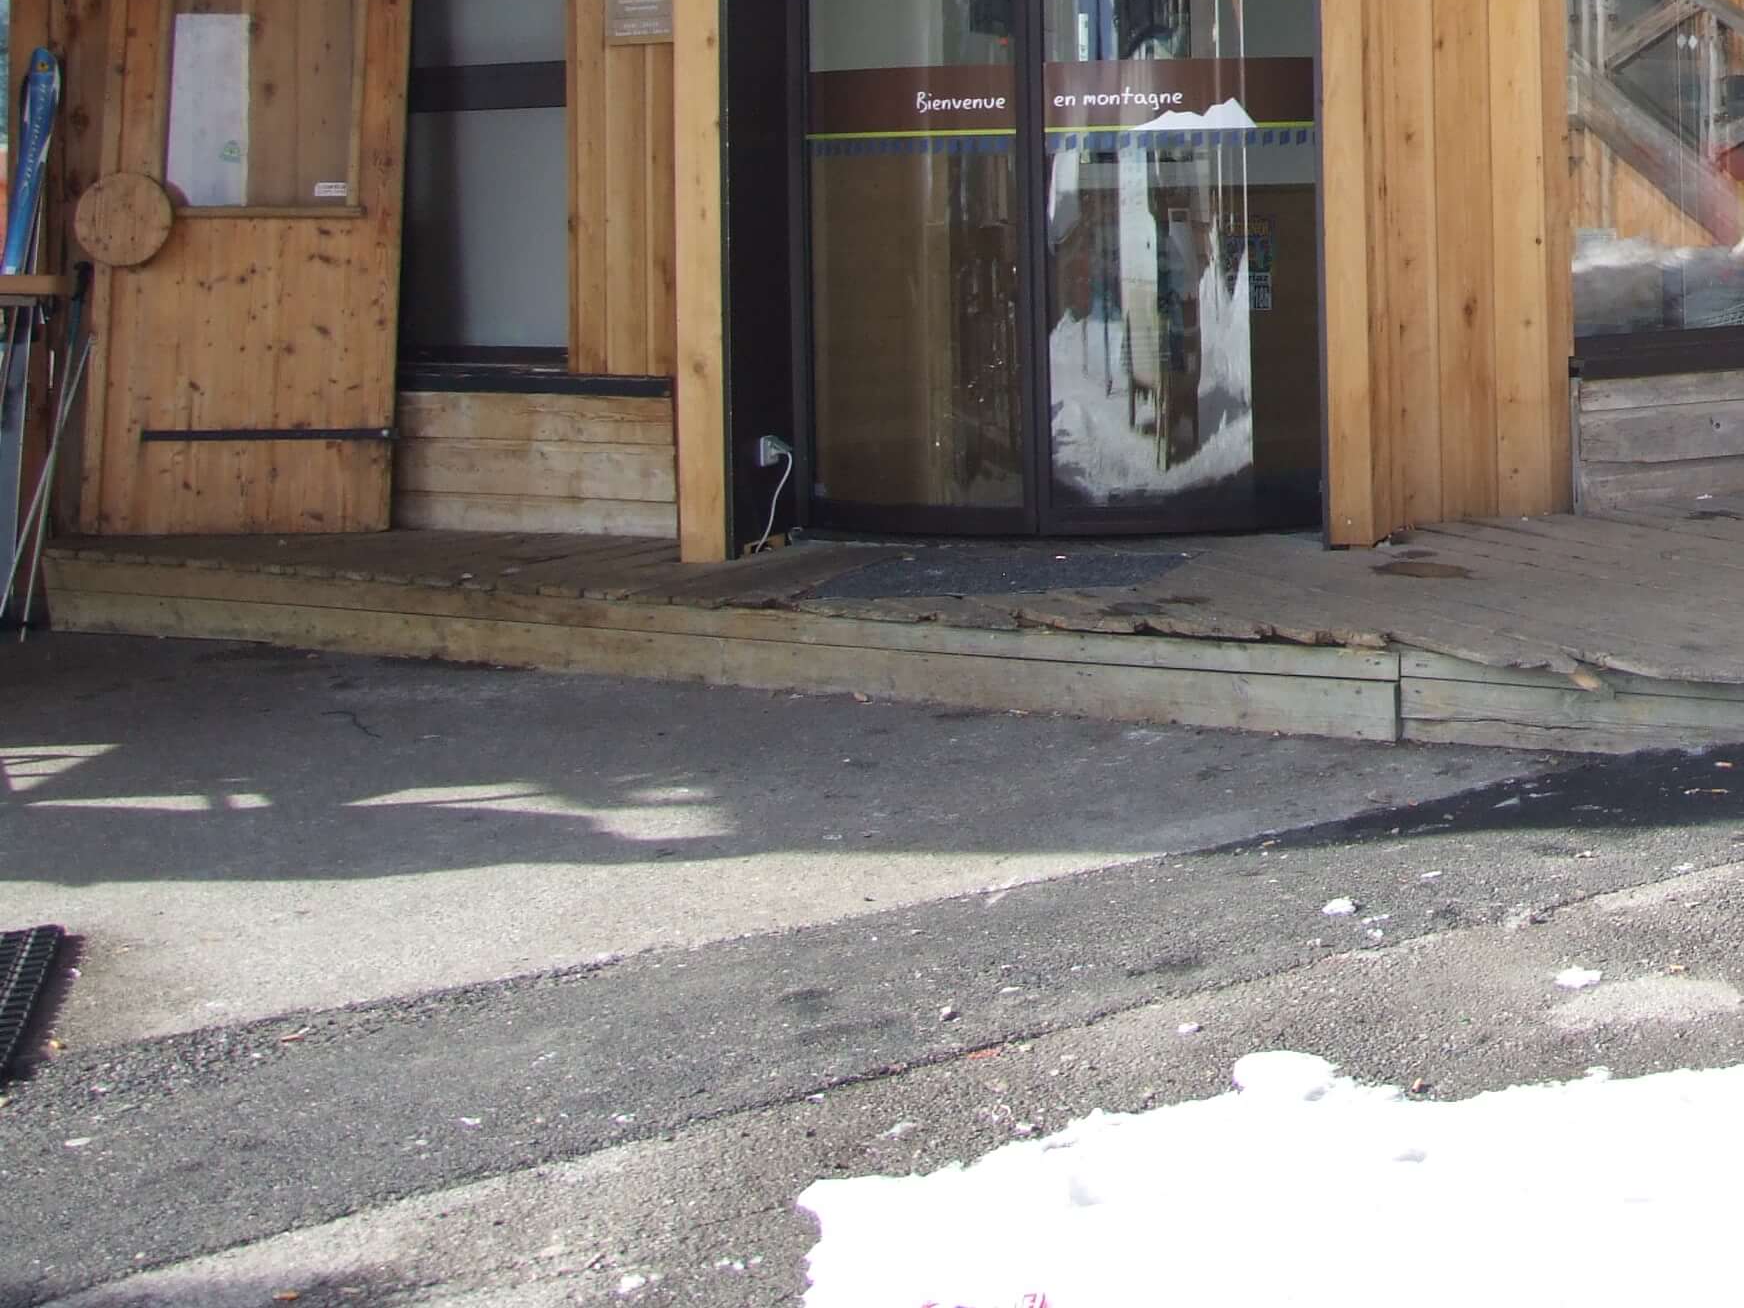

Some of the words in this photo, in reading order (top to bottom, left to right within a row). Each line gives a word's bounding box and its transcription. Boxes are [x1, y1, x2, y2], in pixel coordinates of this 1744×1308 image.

[915, 91, 1006, 113] Bienvenue
[1053, 94, 1076, 108] en
[1082, 86, 1183, 111] montagne
